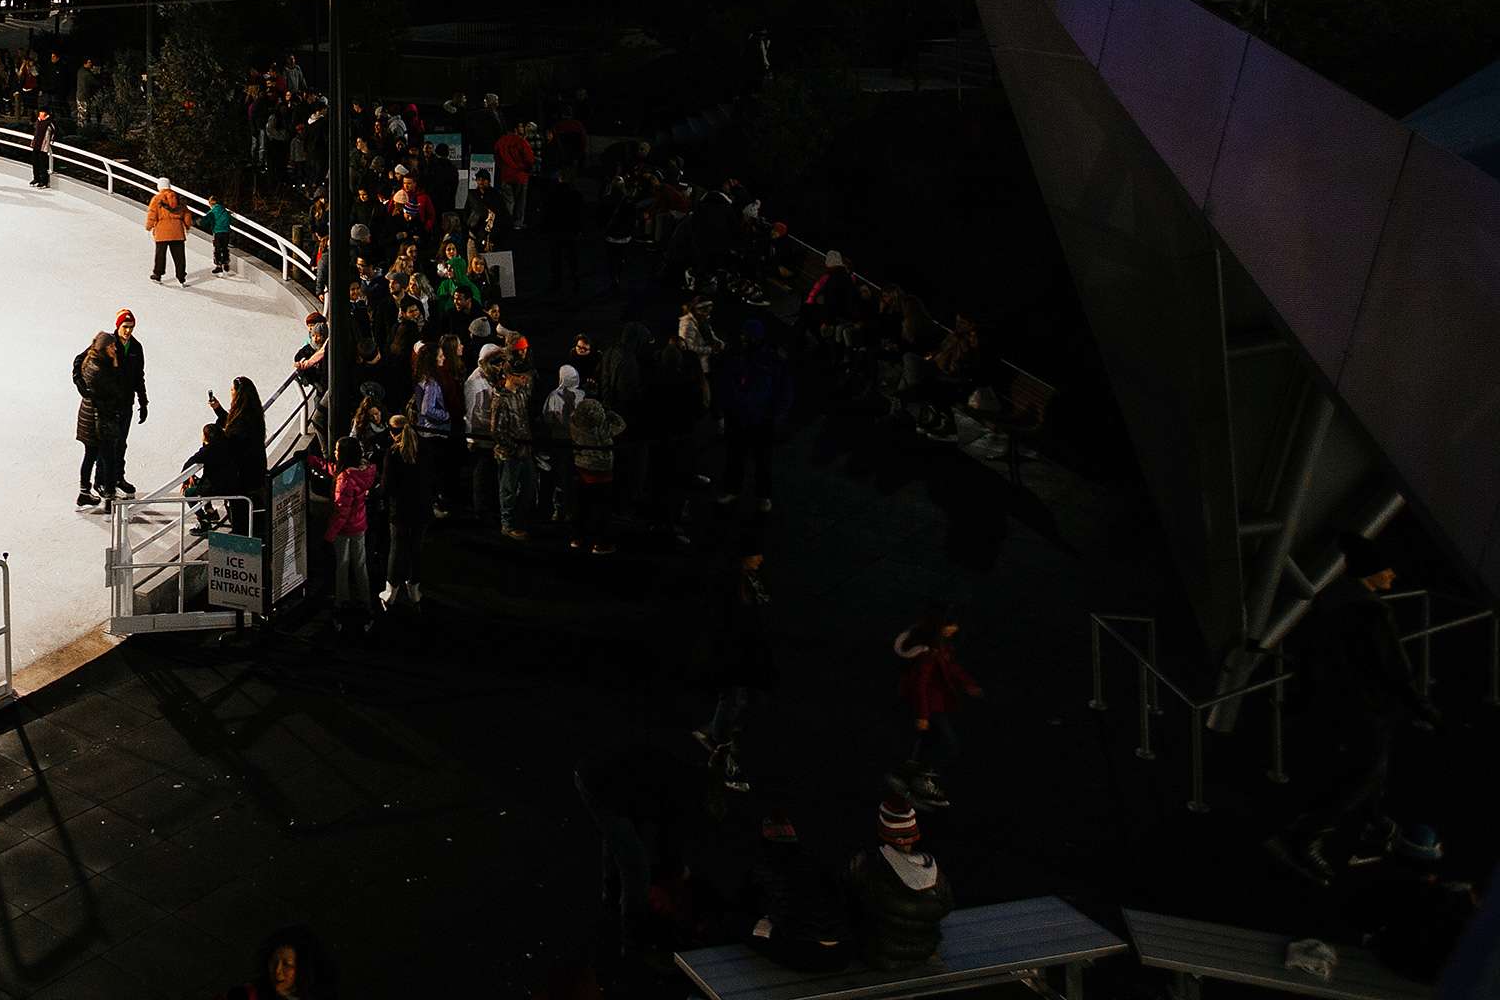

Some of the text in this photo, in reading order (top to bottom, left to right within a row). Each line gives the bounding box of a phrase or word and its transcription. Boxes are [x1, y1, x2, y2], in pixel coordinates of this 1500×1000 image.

[227, 557, 245, 568] ICE
[213, 567, 257, 583] RIBBON
[210, 580, 260, 598] ENTRANCE
